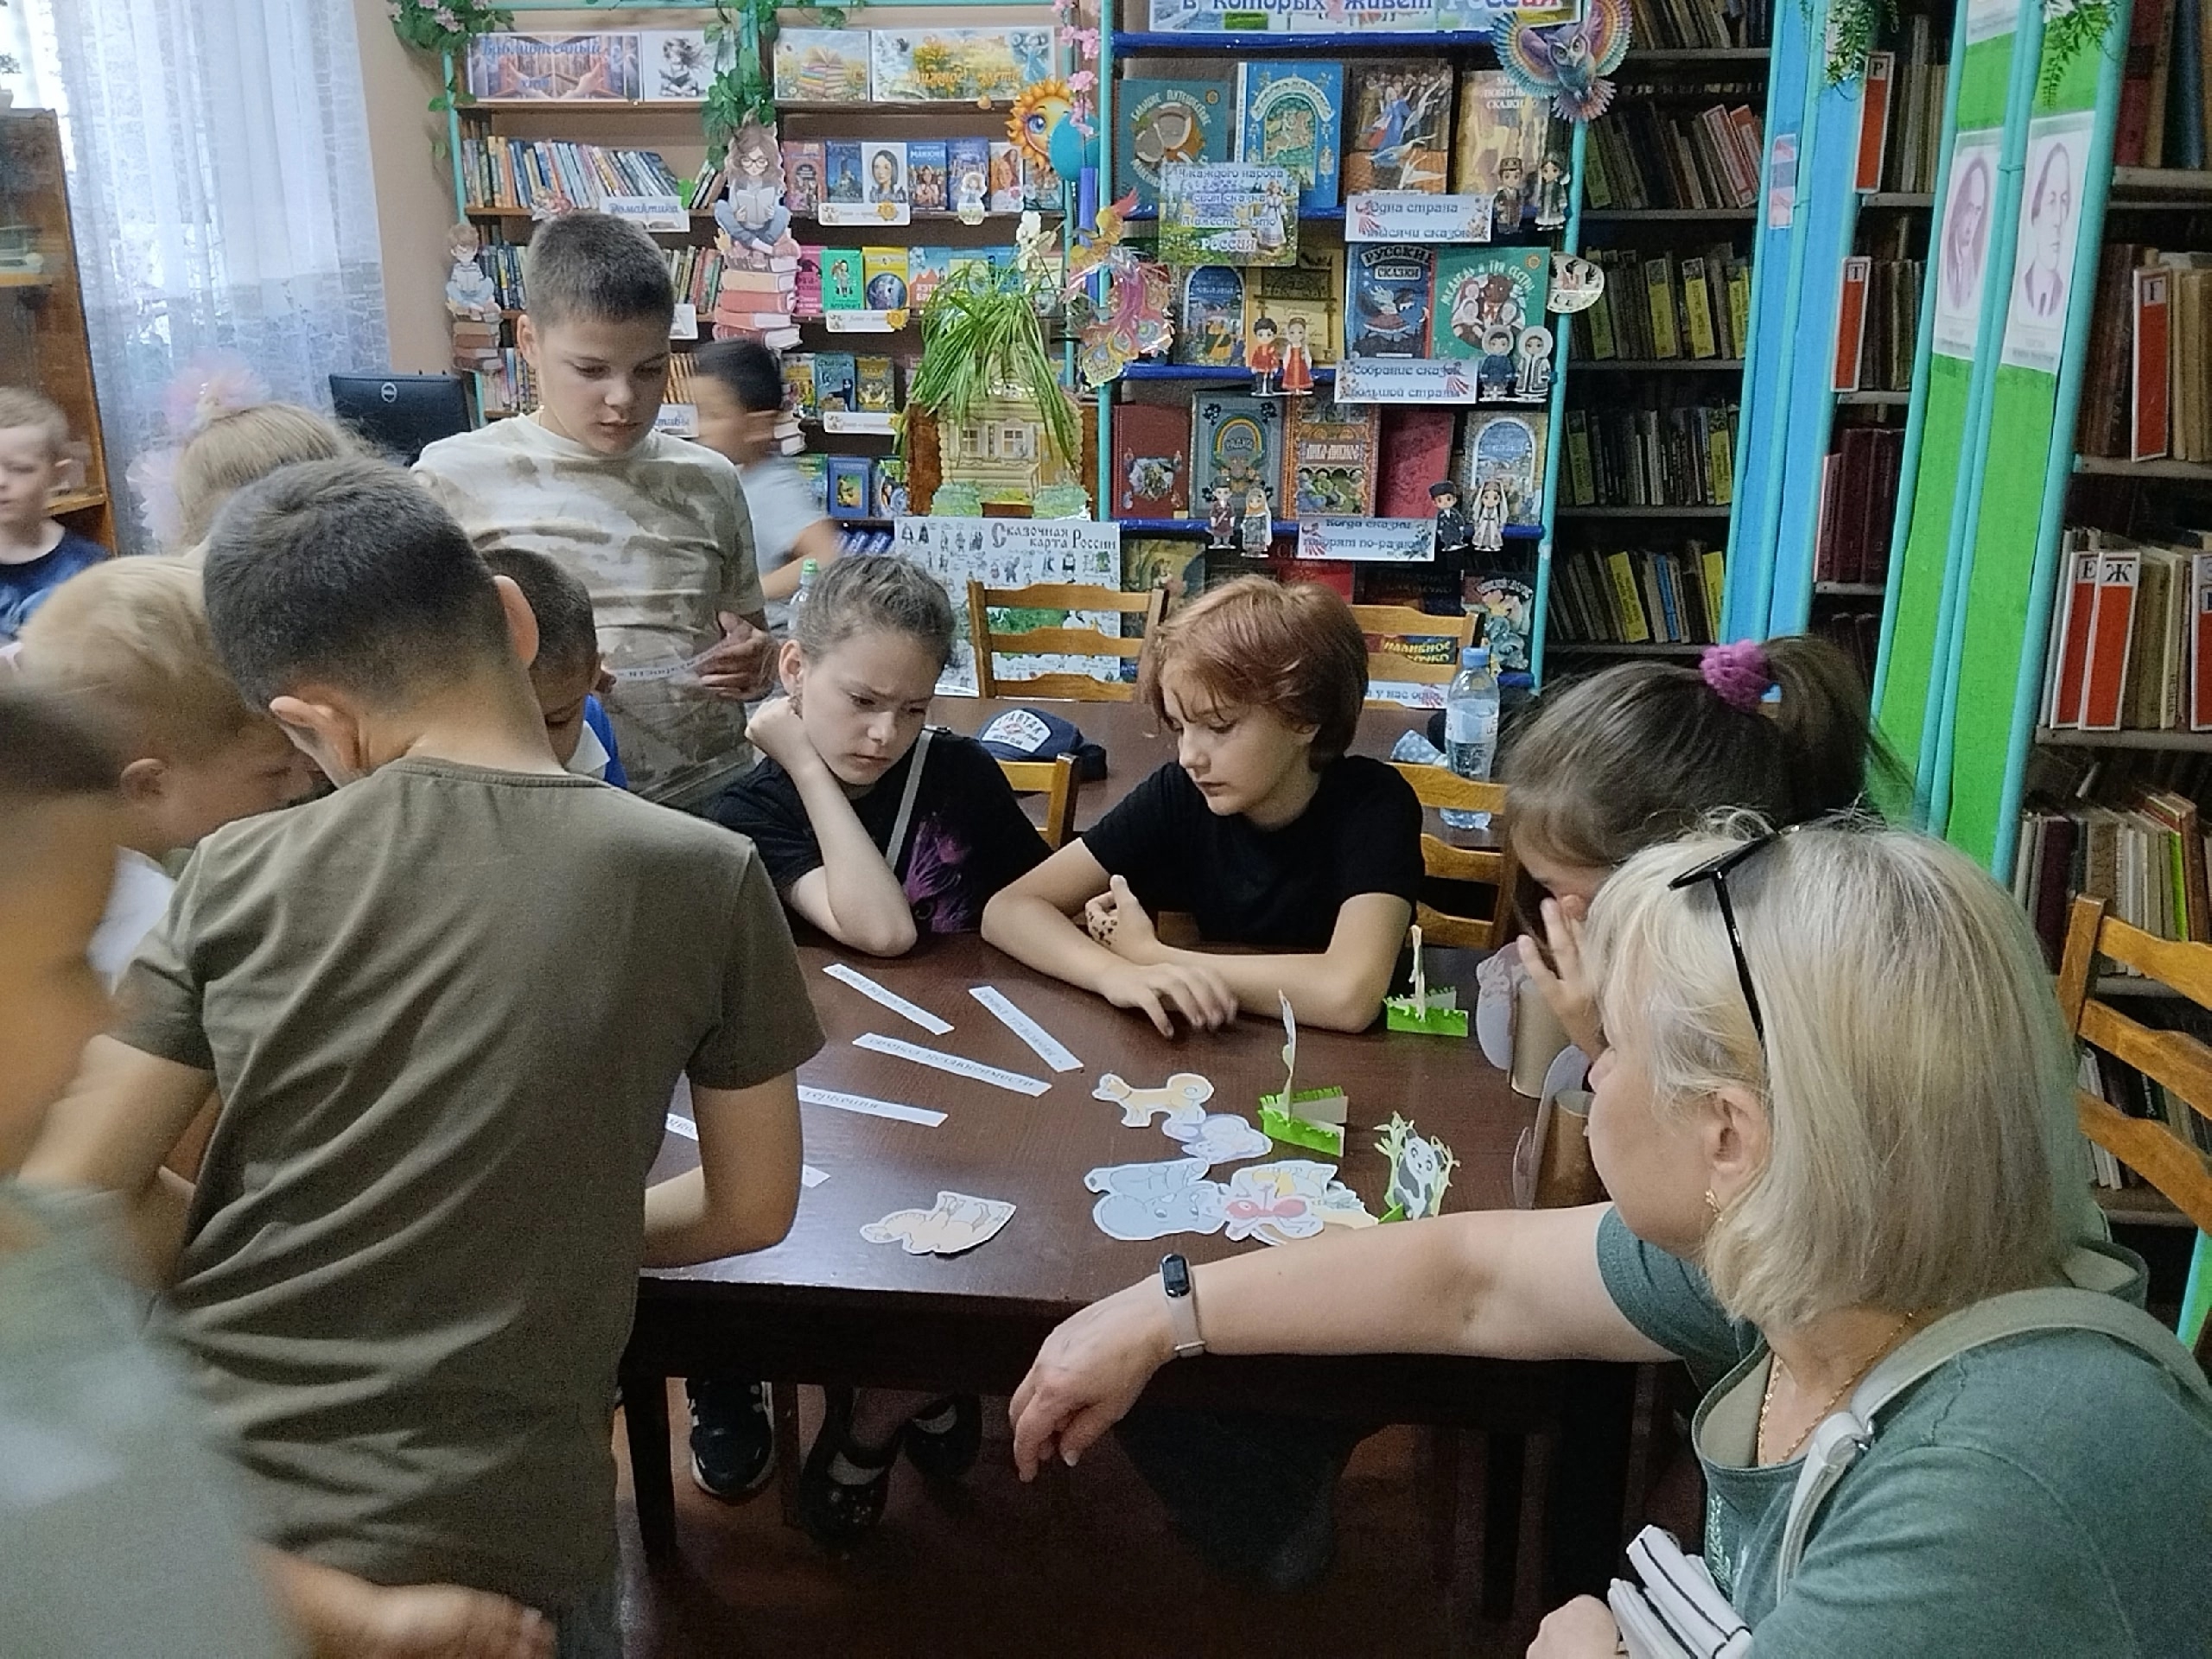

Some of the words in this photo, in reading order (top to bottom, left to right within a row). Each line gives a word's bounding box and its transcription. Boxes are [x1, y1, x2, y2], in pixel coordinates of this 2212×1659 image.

[1407, 203, 1458, 215] страна
[1377, 267, 1419, 277] СКАЗКИ
[1353, 365, 1413, 378] Собрание
[991, 522, 1069, 549] Сказочная
[1029, 537, 1068, 551] карта
[1072, 528, 1116, 550] России
[2106, 563, 2133, 582] Ж
